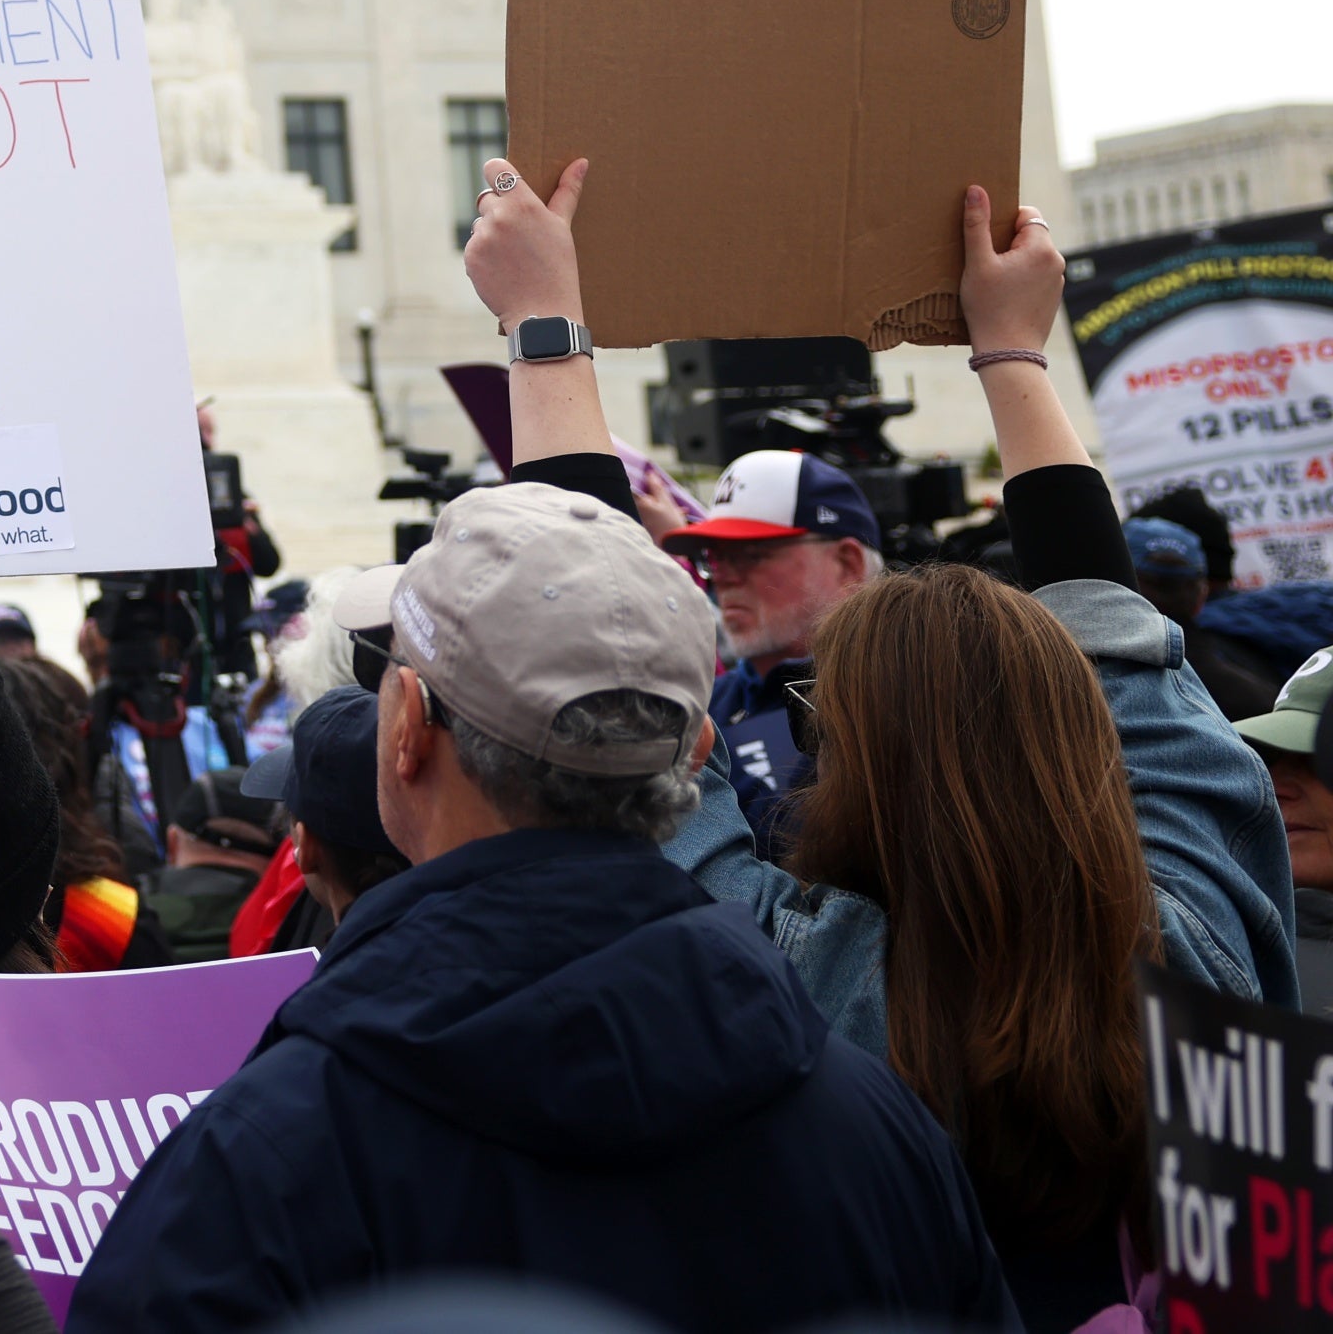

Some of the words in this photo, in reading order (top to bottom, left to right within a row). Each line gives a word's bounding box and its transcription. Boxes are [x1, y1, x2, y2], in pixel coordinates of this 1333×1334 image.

[1205, 372, 1290, 405] ONLY
[1183, 413, 1222, 442] 12
[1231, 395, 1333, 437] PILLS
[1, 525, 54, 545] what.
[1145, 995, 1170, 1122] I
[1177, 1025, 1286, 1160] will
[1158, 1146, 1238, 1292] for
